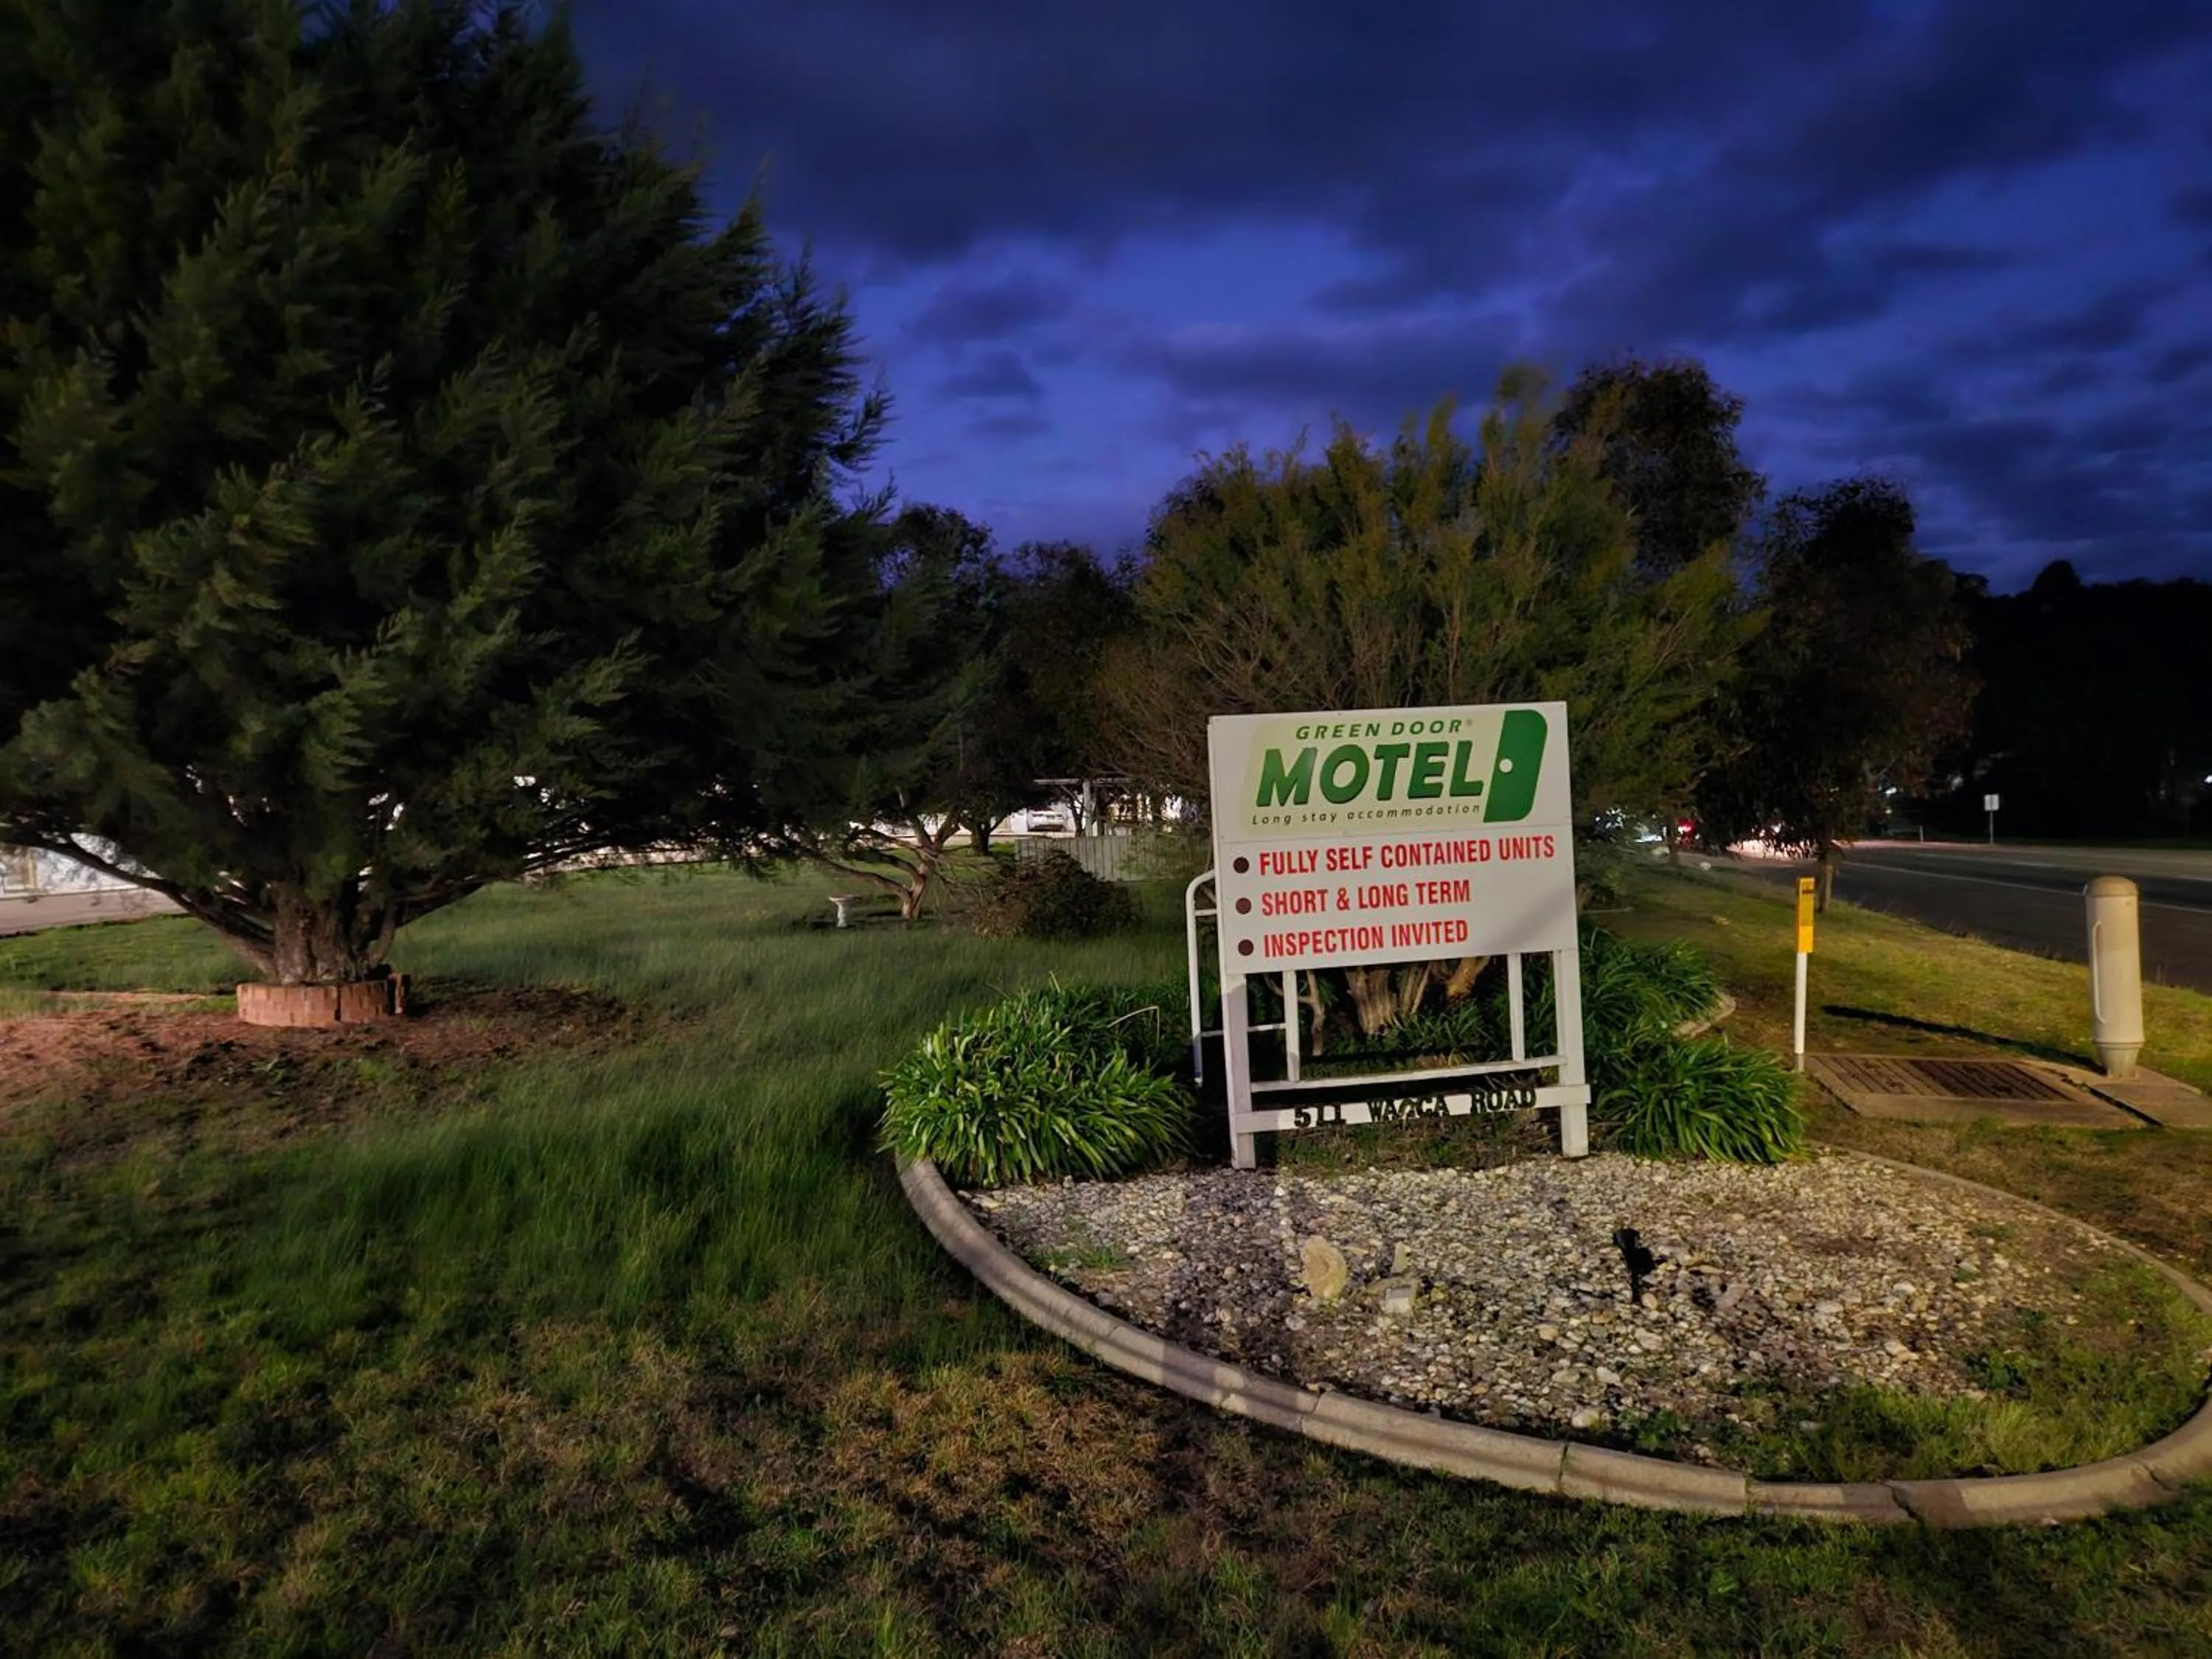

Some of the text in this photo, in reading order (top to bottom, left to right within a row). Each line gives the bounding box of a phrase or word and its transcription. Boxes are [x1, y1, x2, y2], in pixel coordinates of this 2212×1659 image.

[1295, 719, 1463, 739] GREEN DOOR
[1256, 740, 1484, 807] MOTEL
[1252, 804, 1481, 825] Long stay accommodation
[1259, 835, 1555, 875] FULLY SELF CONTAINED UNITS
[1262, 880, 1470, 916] SHORT & LONG TERM
[1264, 919, 1468, 958] INSPECTION INVITED
[1294, 1104, 1346, 1127] 511
[1470, 1088, 1537, 1114] ROAD
